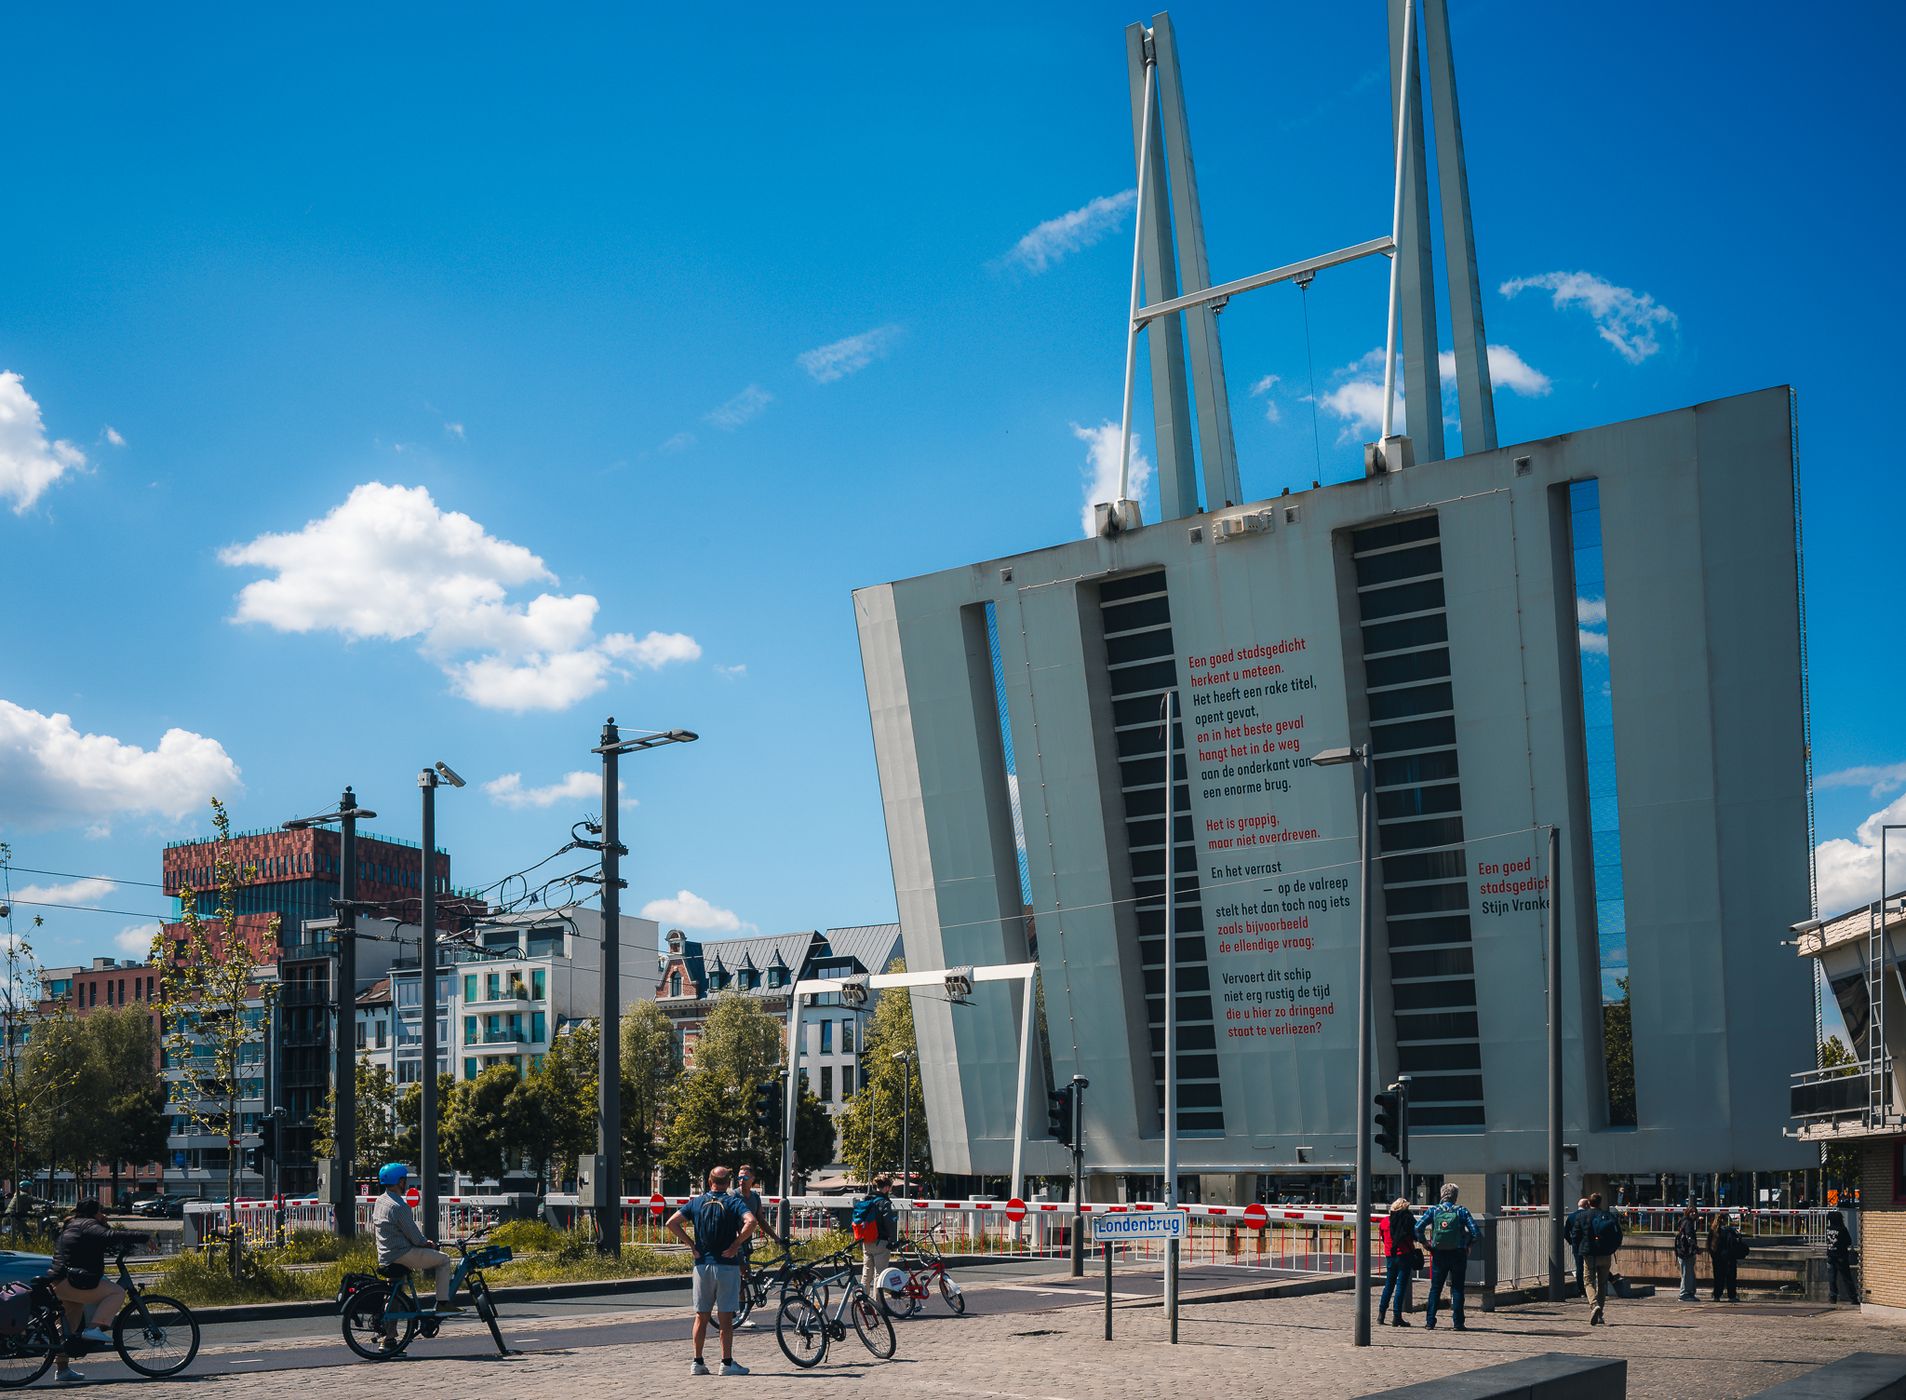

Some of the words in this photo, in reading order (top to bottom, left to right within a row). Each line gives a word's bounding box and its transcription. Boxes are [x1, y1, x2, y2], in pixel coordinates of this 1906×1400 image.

[1189, 656, 1206, 668] Een
[1210, 649, 1234, 668] goed
[1237, 637, 1306, 660] stadsgedicht
[1191, 670, 1231, 687] herkent
[1233, 671, 1239, 681] u
[1242, 664, 1284, 679] meteen.
[1193, 693, 1211, 706] Het
[1213, 687, 1241, 702] heeft
[1243, 688, 1262, 698] een
[1265, 681, 1288, 695] rake
[1291, 675, 1316, 691] titel,
[1195, 710, 1224, 727] opent
[1227, 705, 1259, 724] gevat,
[1197, 733, 1209, 743] en
[1212, 729, 1221, 741] in
[1224, 727, 1241, 739] het
[1244, 721, 1272, 736] beste
[1276, 715, 1304, 735] geval
[1199, 747, 1228, 762] hangt
[1230, 745, 1248, 757] het
[1250, 743, 1260, 754] in
[1263, 739, 1275, 753] de
[1278, 739, 1300, 752] weg
[1201, 770, 1219, 780] aan
[1222, 764, 1234, 778] de
[1238, 758, 1290, 775] onderkant
[1293, 757, 1312, 768] van
[1203, 788, 1221, 799] een
[1224, 783, 1261, 796] enorme
[1264, 778, 1291, 792] brug.
[1206, 819, 1224, 831] Het
[1226, 817, 1235, 829] is
[1238, 813, 1280, 831] grappig,
[1208, 839, 1233, 849] maar
[1236, 834, 1256, 846] niet
[1259, 828, 1320, 844] overdreven.
[1211, 867, 1223, 878] En
[1225, 865, 1242, 877] het
[1245, 861, 1282, 875] verrast
[1478, 862, 1499, 875] Een
[1503, 857, 1530, 876] goed
[1278, 884, 1290, 896] op
[1294, 880, 1306, 892] de
[1309, 877, 1348, 891] valreep
[1480, 875, 1549, 895] stadsgedich
[1216, 904, 1239, 917] stelt
[1241, 903, 1258, 915] het
[1261, 901, 1279, 914] dan
[1281, 898, 1305, 912] toch
[1308, 899, 1327, 912] nog
[1330, 896, 1350, 908] iets
[1482, 900, 1509, 916] Stijn
[1512, 896, 1549, 912] Vranke
[1218, 921, 1243, 935] zoals
[1246, 916, 1308, 936] bijvoorbeeld
[1220, 940, 1231, 953] de
[1234, 935, 1279, 953] ellendige
[1282, 937, 1314, 950] vraag:
[1222, 971, 1265, 984] Vervoert
[1267, 969, 1281, 982] dit
[1284, 968, 1311, 982] schip
[1224, 991, 1243, 1002] niet
[1246, 992, 1262, 1003] erg
[1265, 987, 1294, 1002] rustig
[1298, 985, 1310, 998] de
[1312, 984, 1330, 999] tijd
[1227, 1008, 1241, 1020] die
[1244, 1010, 1250, 1019] u
[1252, 1006, 1272, 1018] hier
[1275, 1009, 1286, 1017] zo
[1289, 1002, 1334, 1019] dringend
[1228, 1026, 1255, 1038] staat
[1256, 1026, 1267, 1036] te
[1269, 1022, 1322, 1035] verliezen?
